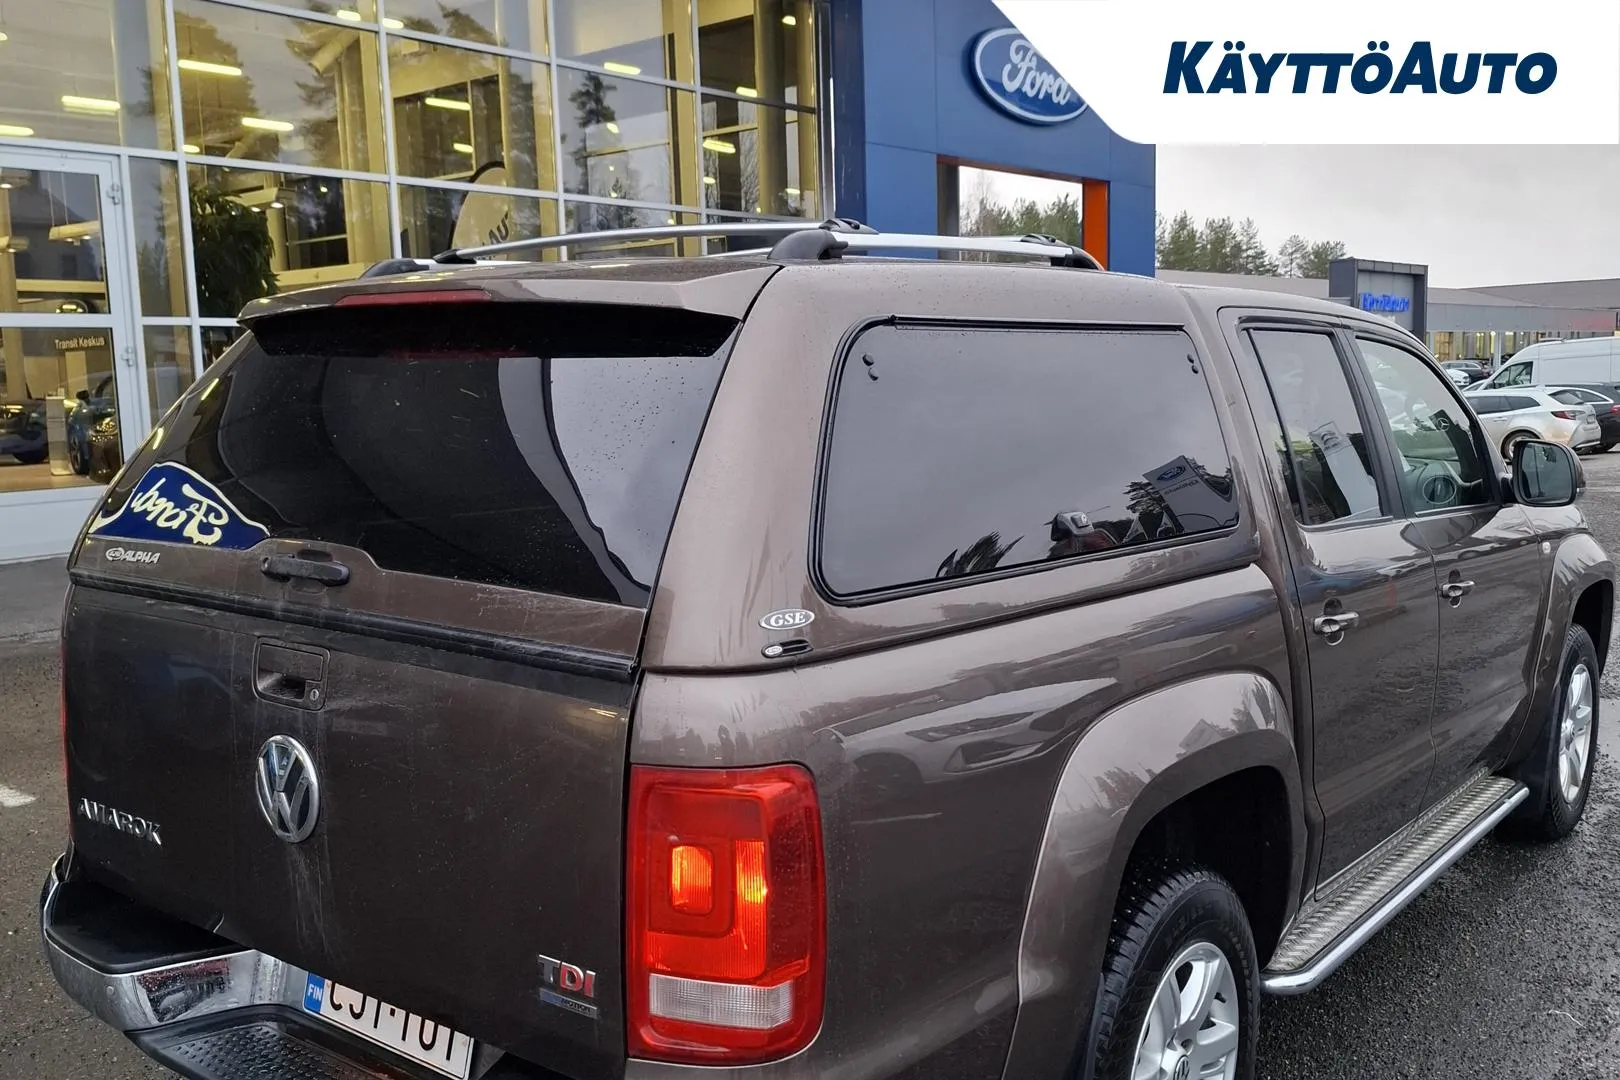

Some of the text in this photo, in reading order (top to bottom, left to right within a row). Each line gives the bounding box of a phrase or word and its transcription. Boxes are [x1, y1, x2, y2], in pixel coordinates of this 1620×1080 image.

[55, 335, 105, 350] Transit Keskus
[121, 550, 161, 564] ALPHA
[769, 612, 806, 627] GSE
[79, 798, 161, 845] AMAROK
[538, 954, 596, 997] TDI
[308, 983, 322, 1001] FIN
